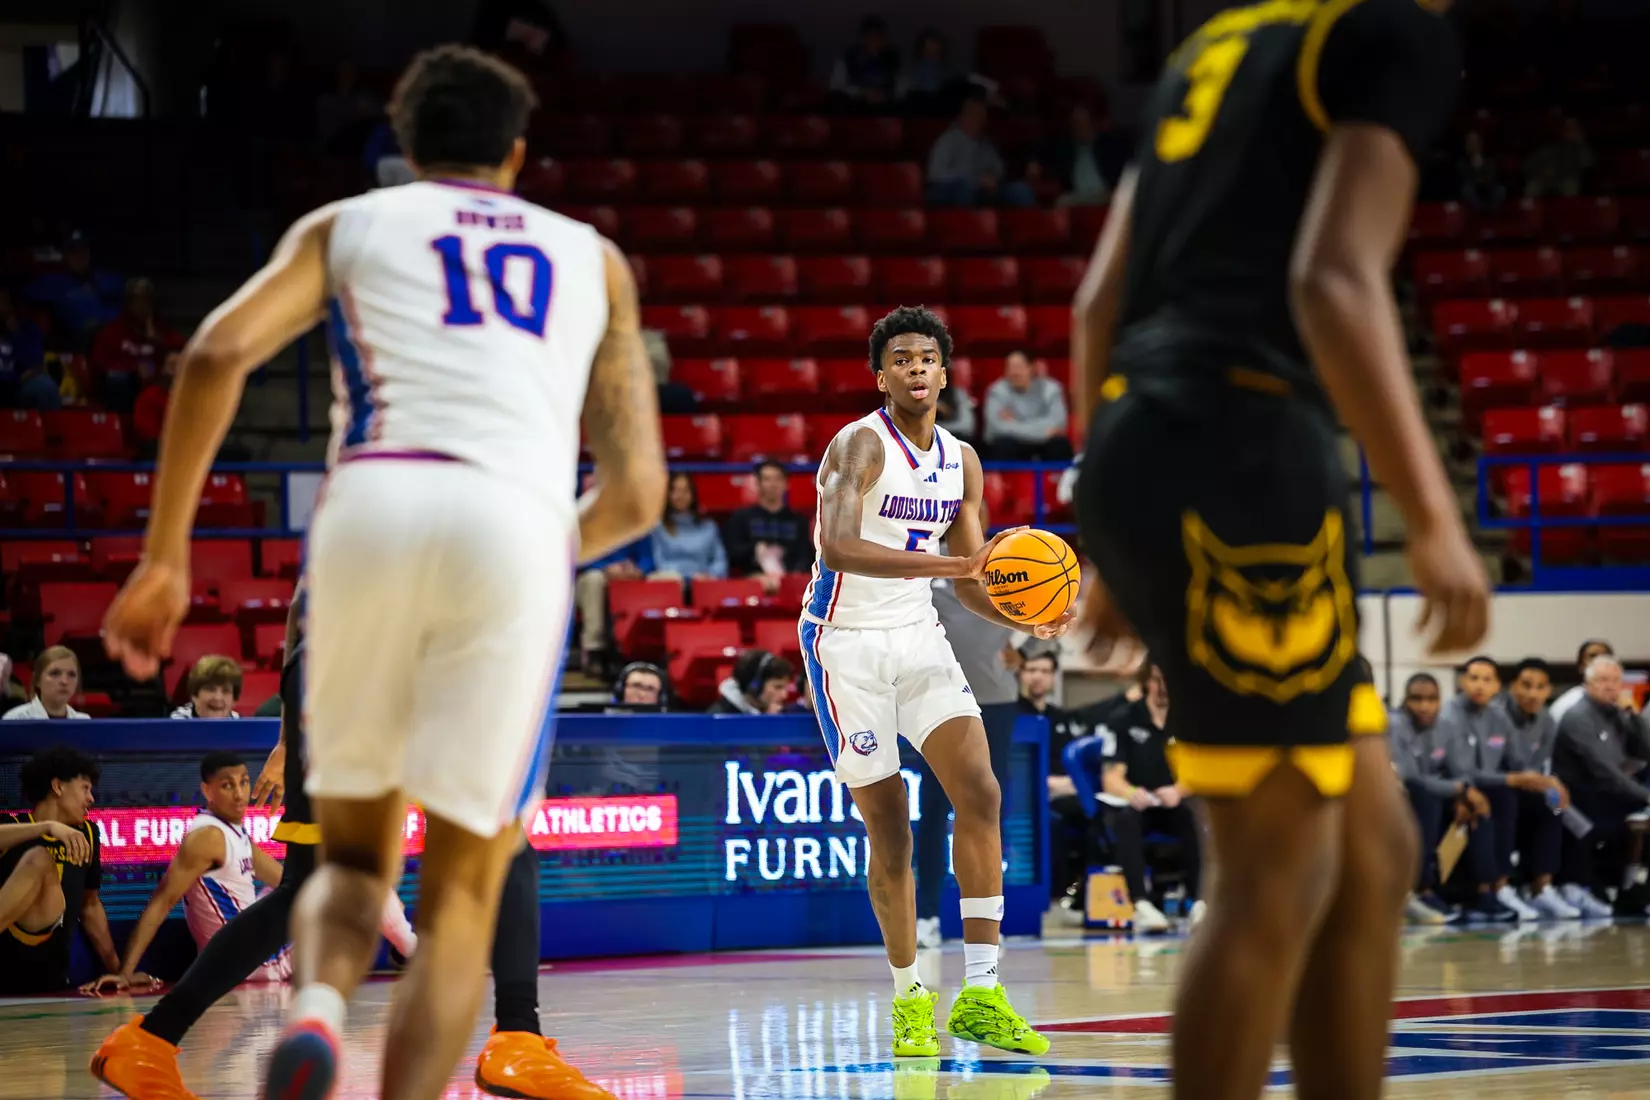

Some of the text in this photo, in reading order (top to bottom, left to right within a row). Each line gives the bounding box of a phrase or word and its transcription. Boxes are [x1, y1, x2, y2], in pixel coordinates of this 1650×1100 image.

[1155, 34, 1248, 163] 3
[430, 235, 553, 338] 10
[878, 493, 939, 523] LOUISIANA
[531, 806, 662, 835] ATHLETICS
[725, 761, 844, 824] Ivan
